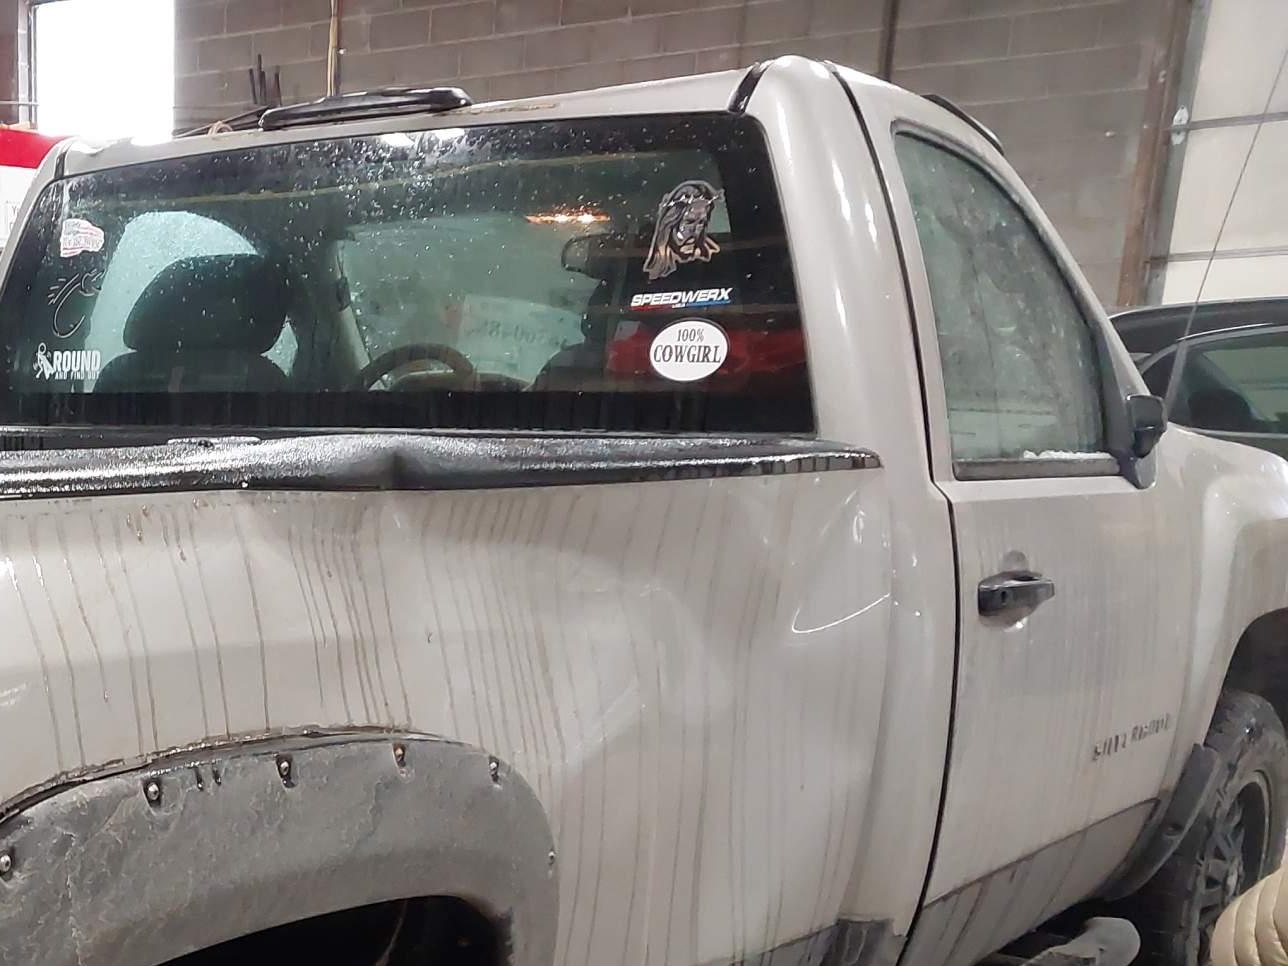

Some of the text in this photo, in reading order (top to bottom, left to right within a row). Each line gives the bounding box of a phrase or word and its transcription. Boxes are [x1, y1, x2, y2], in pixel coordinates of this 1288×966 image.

[630, 287, 733, 305] SPEEDWERX
[677, 328, 704, 342] 100%
[53, 350, 101, 372] ROUND
[653, 344, 721, 363] COWGIRL
